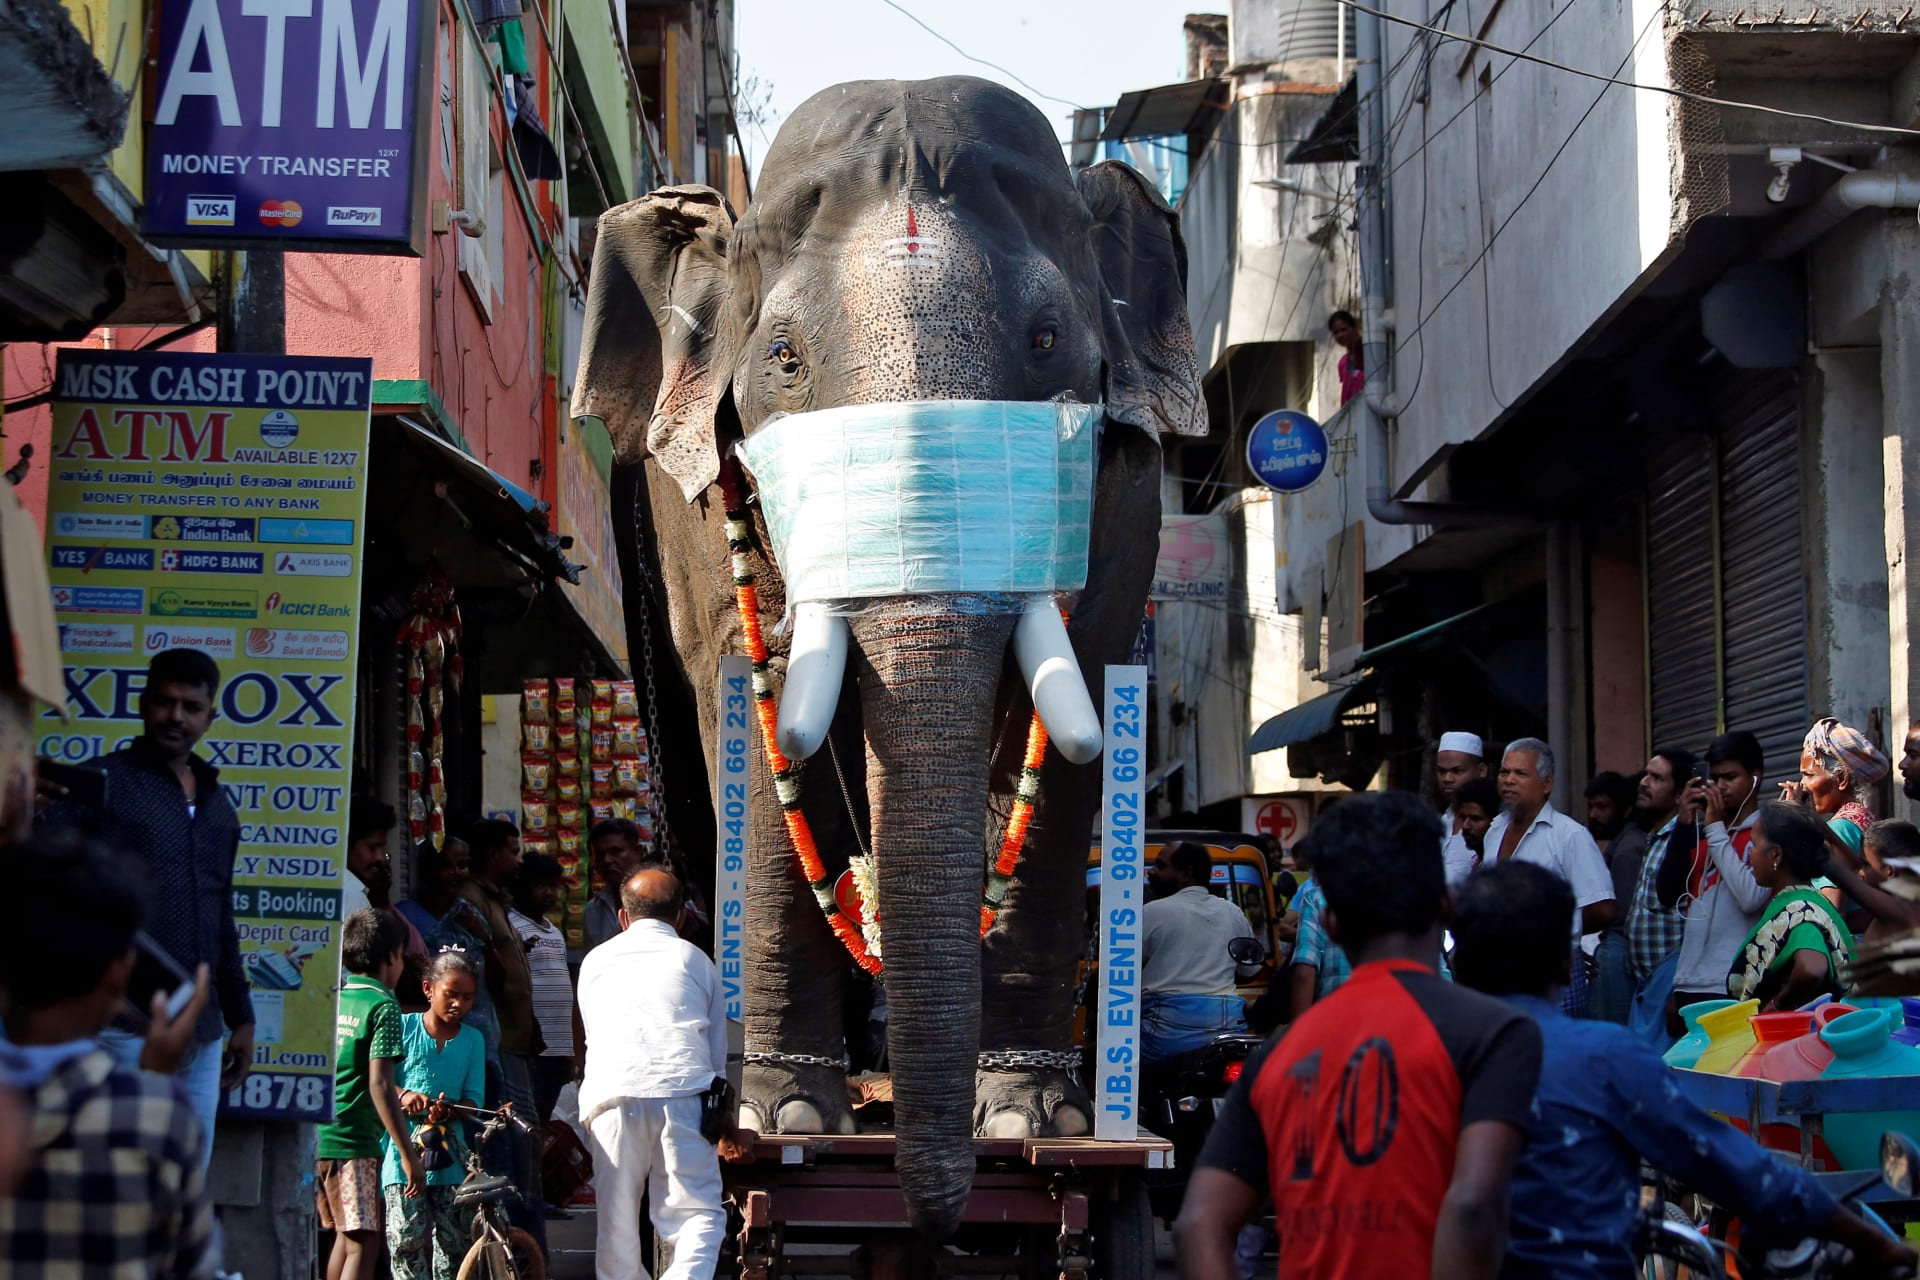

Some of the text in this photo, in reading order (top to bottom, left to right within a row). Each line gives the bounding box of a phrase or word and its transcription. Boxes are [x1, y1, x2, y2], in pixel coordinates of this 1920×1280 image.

[155, 0, 409, 130] ATM
[378, 149, 399, 157] 12X7
[163, 154, 391, 178] MONEY TRANSFER
[194, 203, 229, 217] VISA
[260, 209, 302, 219] MasterCard
[331, 209, 370, 222] RuPay
[62, 362, 366, 406] MSK CASH POINT
[56, 408, 233, 463] ATM
[233, 450, 358, 465] AVAILABLE 12X7
[109, 470, 156, 485] பணம்
[240, 474, 292, 488] சேவை
[298, 475, 356, 490] மையம்
[82, 492, 320, 510] MONEY TRANSFER TO ANY BANK
[183, 528, 219, 541] Indian
[221, 529, 252, 542] Bank
[57, 550, 149, 566] YES BANK
[183, 555, 259, 569] HDFC BANK
[300, 558, 349, 567] AXIS BANK
[1187, 581, 1225, 596] CLINIC
[279, 602, 351, 617] ICICI Bank
[172, 636, 232, 646] Union Bank
[283, 646, 346, 656] Bank of Baroda
[42, 667, 343, 726] XEOX
[727, 675, 746, 729] 234
[1113, 684, 1140, 738] 234
[206, 742, 342, 768] XEROX
[726, 738, 745, 774] 66
[1113, 747, 1139, 783] 66
[724, 783, 743, 872] 98402
[1110, 792, 1139, 882] 98402
[267, 859, 336, 877] NSDL
[258, 888, 336, 919] Booking
[238, 924, 330, 945] Depit Card
[723, 898, 741, 1019] EVENTS
[1107, 907, 1136, 1027] EVENTS
[1105, 1036, 1133, 1120] J.B.S.
